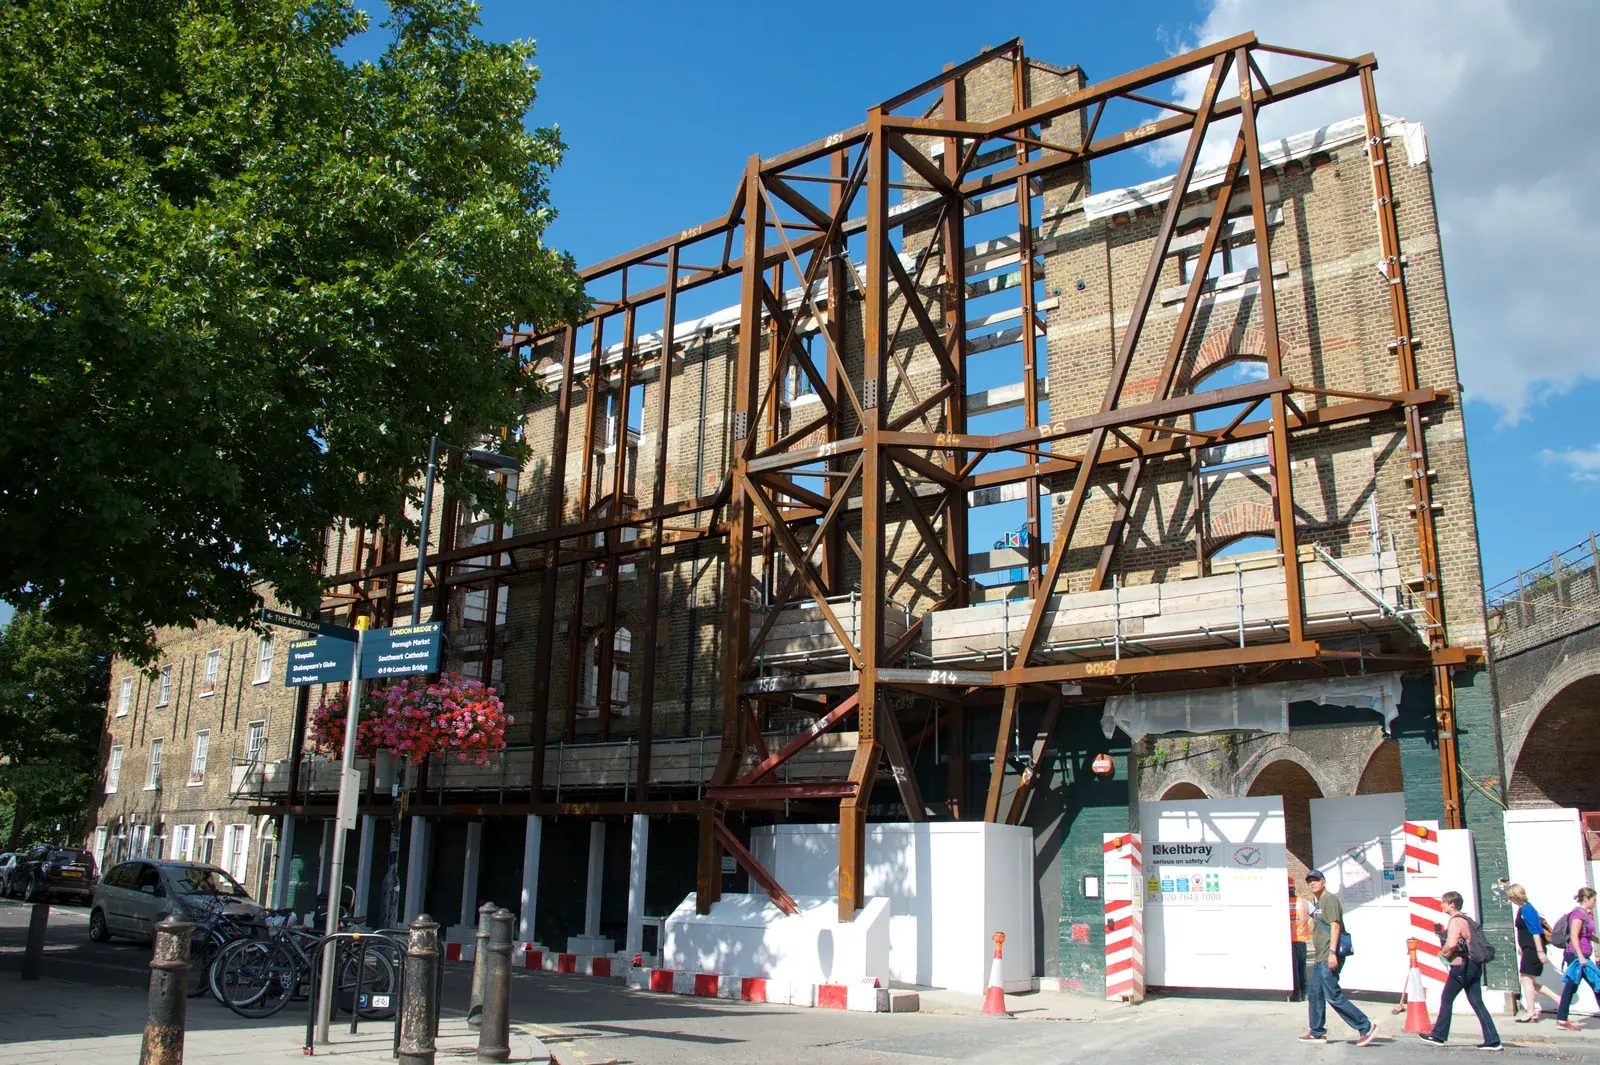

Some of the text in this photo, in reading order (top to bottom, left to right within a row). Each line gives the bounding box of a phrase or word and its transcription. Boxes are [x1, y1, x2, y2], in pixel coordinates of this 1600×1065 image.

[1124, 124, 1157, 142] B45
[824, 133, 844, 148] B51
[1038, 422, 1067, 438] B6
[817, 442, 837, 457] B51
[275, 614, 320, 630] THE BOROUGH
[389, 625, 432, 636] LONDON BRIDGE
[295, 640, 318, 648] BANKSIDE
[391, 638, 431, 648] Borough Market
[377, 651, 430, 662] Southwark Cathedral
[292, 660, 337, 672] Shakespeare's Globe
[411, 664, 428, 673] Bridge
[928, 669, 958, 685] B14
[811, 716, 829, 737] B15
[1162, 844, 1213, 856] keltbray
[1184, 857, 1204, 865] safety
[1179, 893, 1199, 902] 7643
[1201, 893, 1222, 902] 1000
